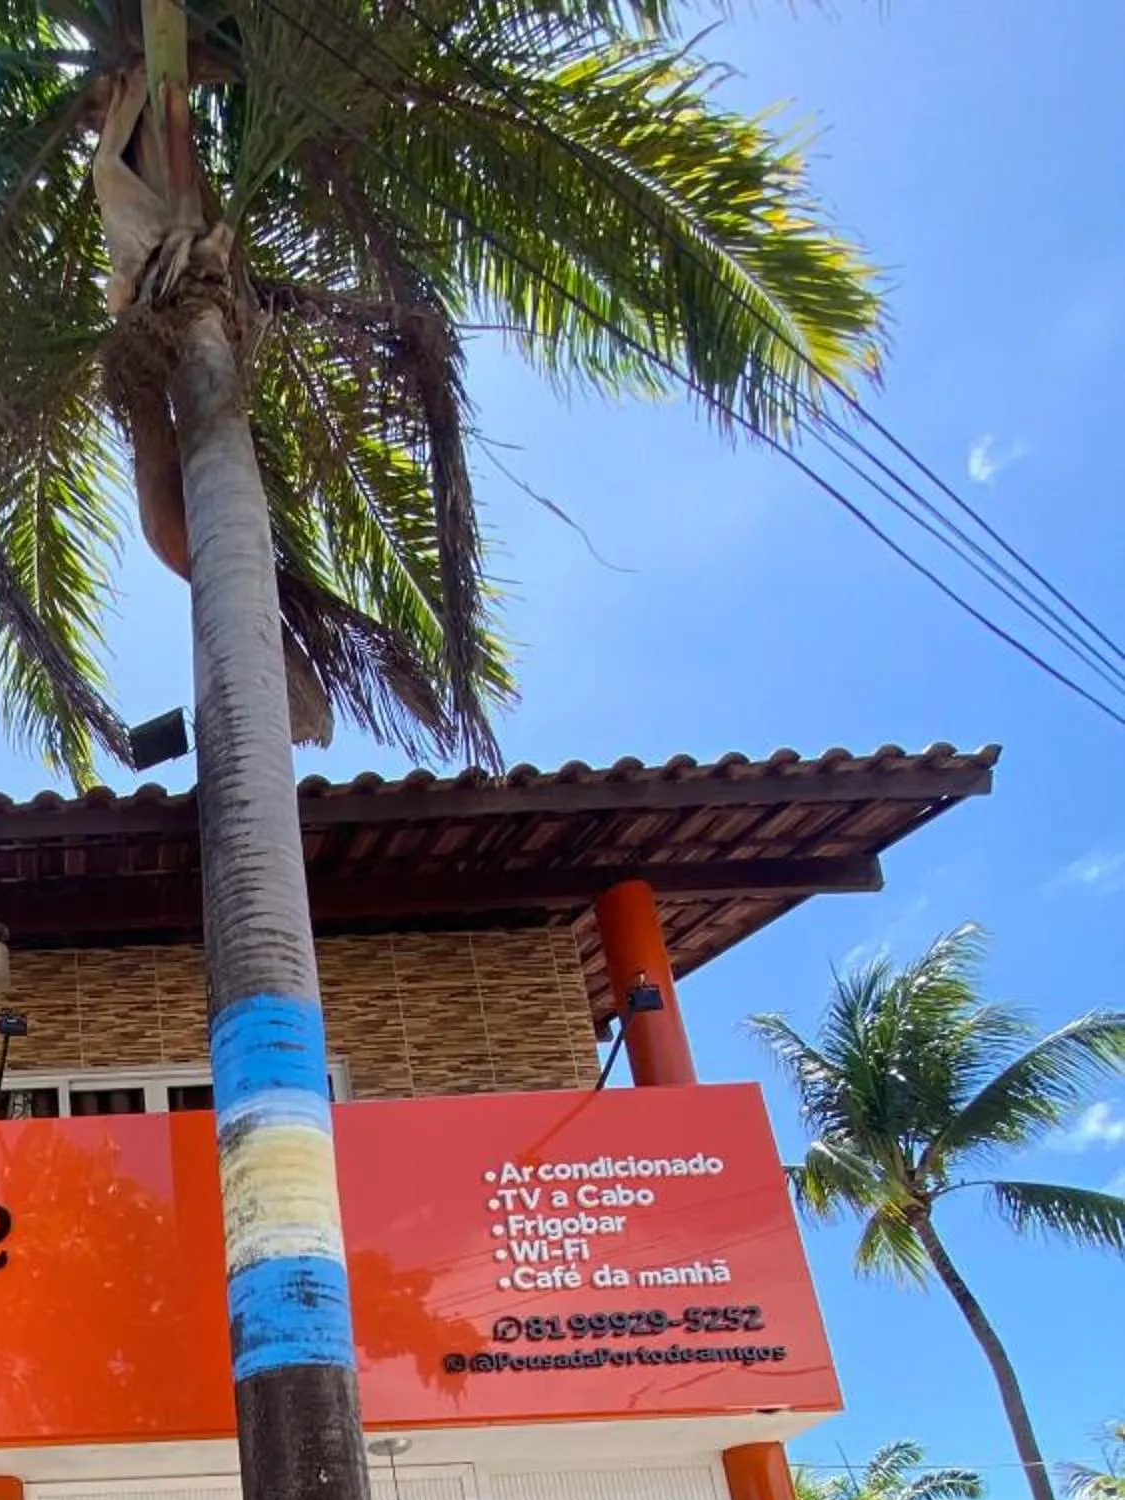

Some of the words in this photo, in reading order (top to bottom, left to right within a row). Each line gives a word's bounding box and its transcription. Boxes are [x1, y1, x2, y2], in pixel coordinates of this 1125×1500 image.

[499, 1163, 535, 1184] Ar
[537, 1152, 724, 1178] condicionado
[496, 1187, 541, 1210] TV
[551, 1190, 569, 1207] a
[577, 1184, 655, 1207] Cabo
[507, 1213, 627, 1240] Frigobar
[511, 1239, 590, 1261] Wi-Fi
[512, 1263, 581, 1289] Café
[592, 1264, 629, 1287] da
[638, 1258, 732, 1286] manhã
[525, 1315, 566, 1341] 81
[567, 1306, 765, 1337] 99929-5252
